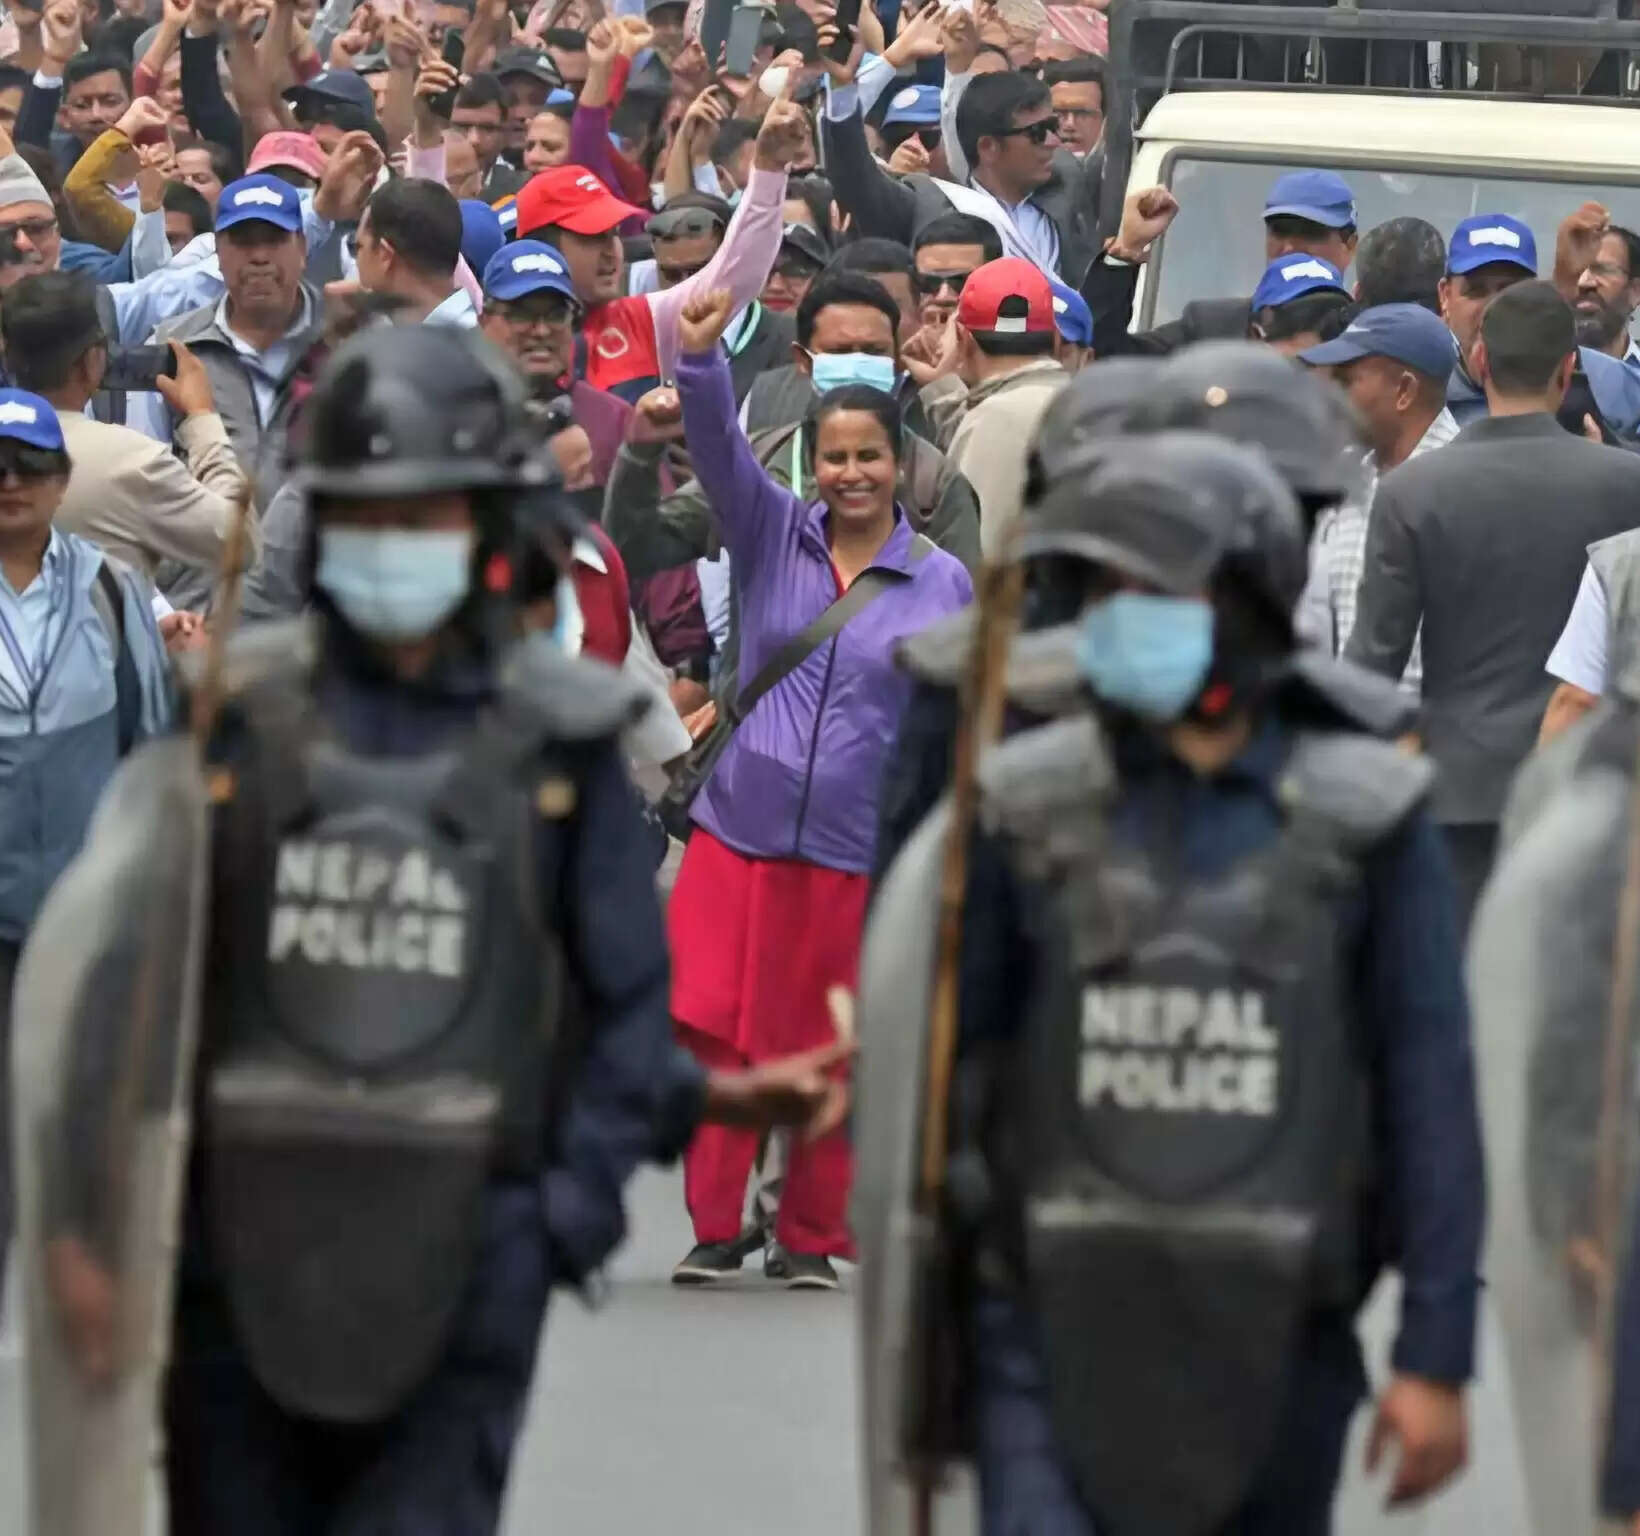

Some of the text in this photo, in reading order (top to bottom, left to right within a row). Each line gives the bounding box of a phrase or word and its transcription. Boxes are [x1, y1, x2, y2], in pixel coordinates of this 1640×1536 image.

[274, 840, 470, 911] NEPAL
[266, 904, 467, 976] POLICE
[1080, 984, 1280, 1051] NEPAL
[1077, 1050, 1279, 1116] POLICE
